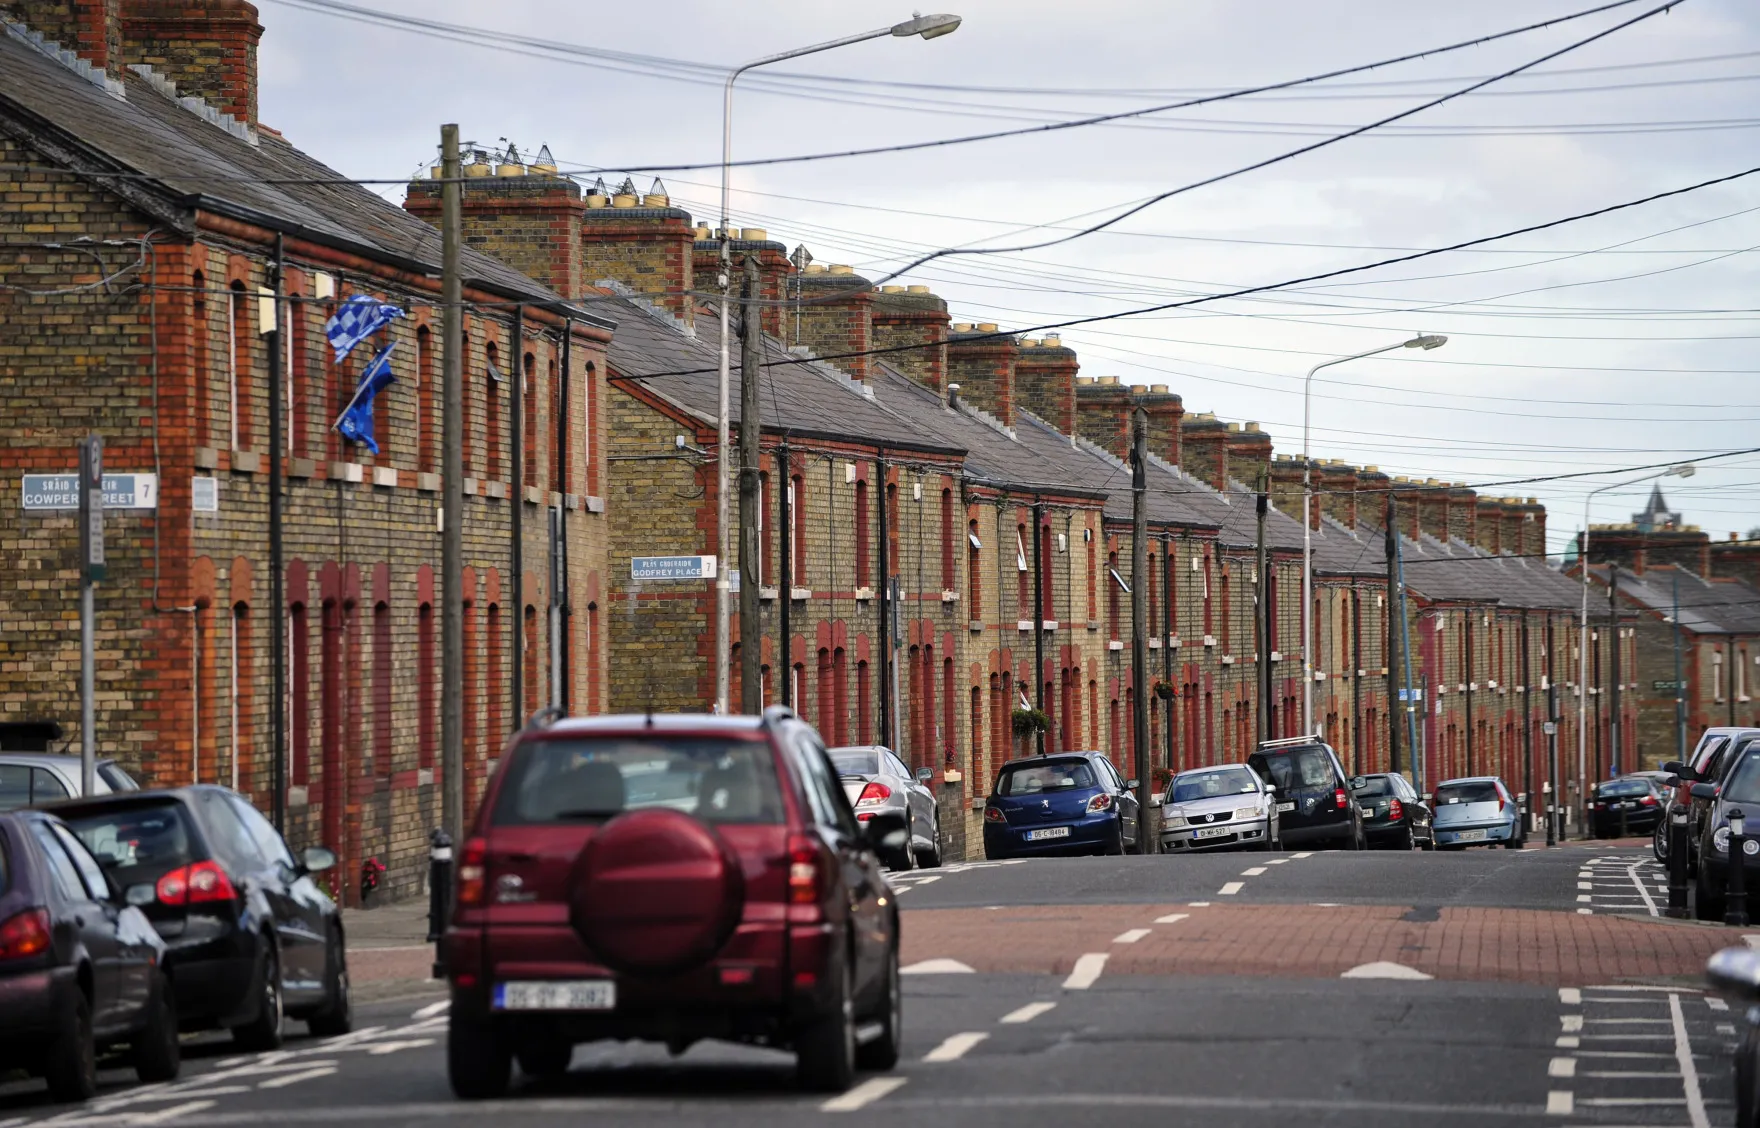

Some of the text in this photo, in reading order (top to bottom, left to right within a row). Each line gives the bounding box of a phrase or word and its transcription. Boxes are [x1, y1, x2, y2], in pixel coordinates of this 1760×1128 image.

[142, 484, 150, 498] 7
[25, 493, 79, 505] COWPER
[633, 568, 702, 577] GODFREY PLACE
[706, 562, 711, 572] 7
